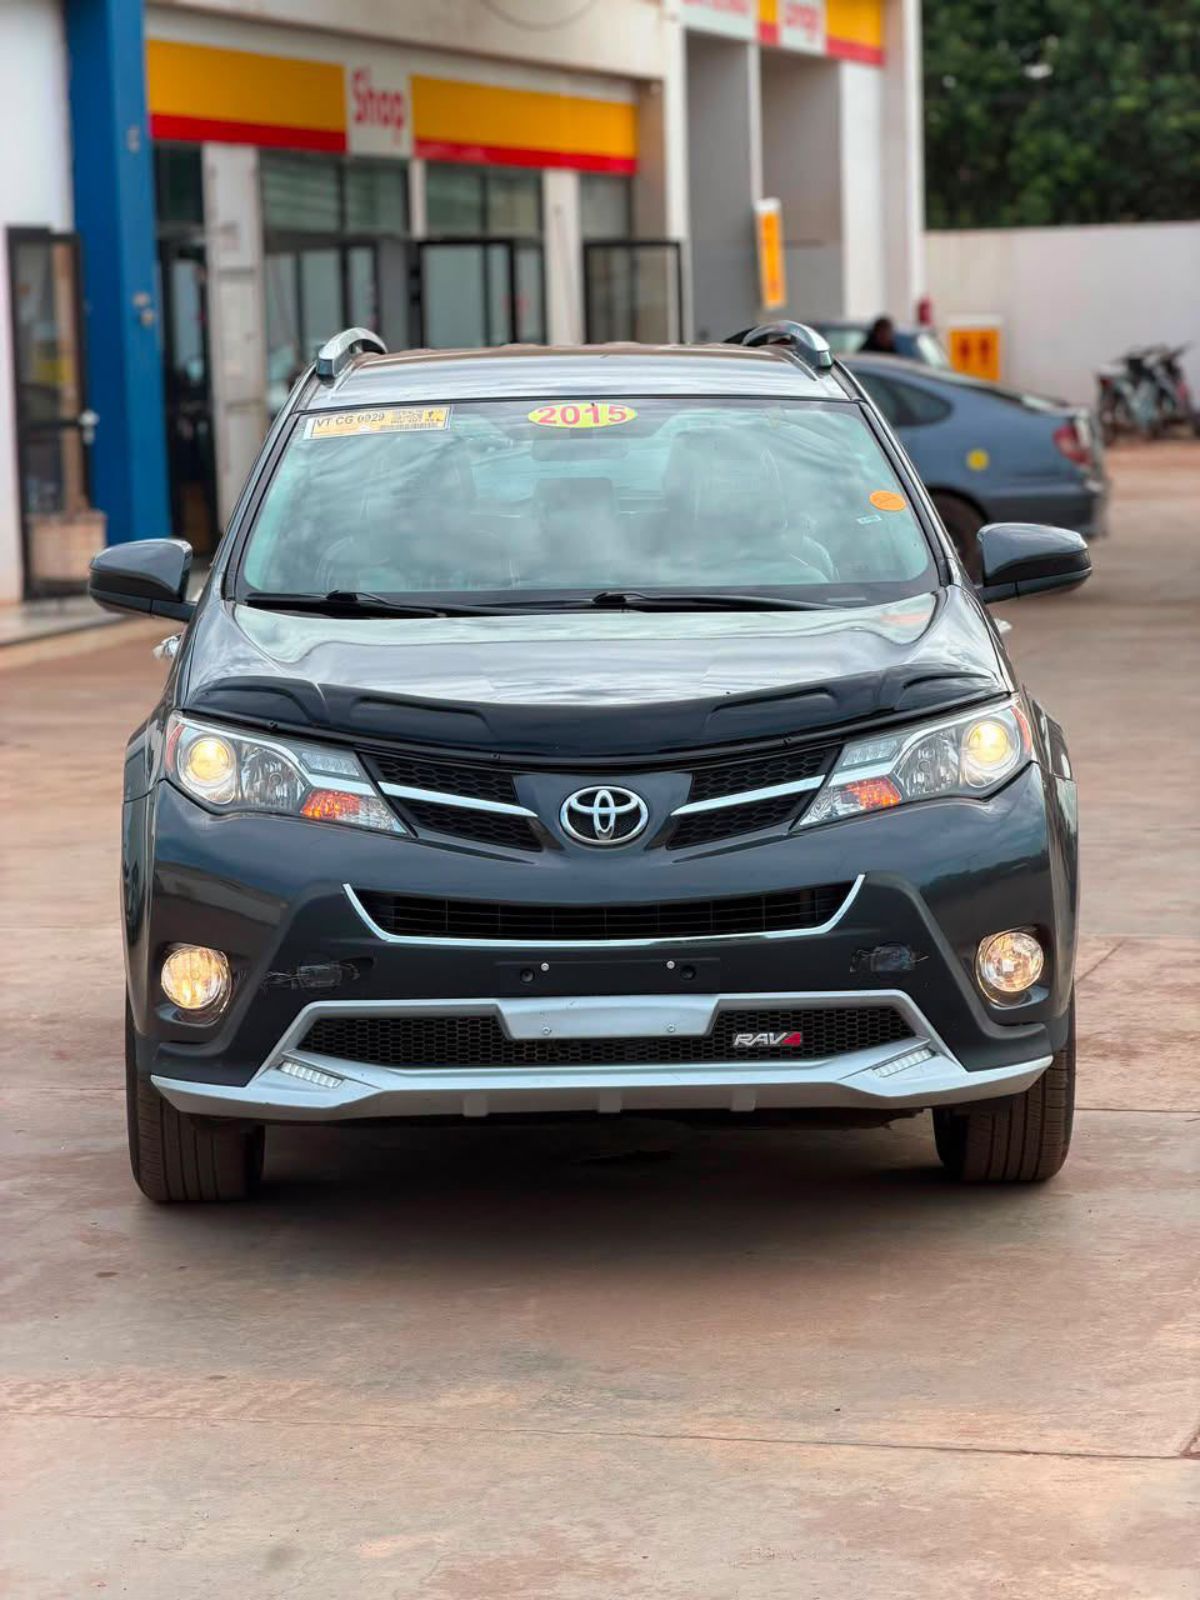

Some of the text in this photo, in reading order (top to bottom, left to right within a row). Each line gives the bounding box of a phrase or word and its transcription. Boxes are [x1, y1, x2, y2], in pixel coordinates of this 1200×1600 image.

[351, 67, 404, 144] Shop
[336, 415, 354, 425] CG
[537, 401, 628, 426] 2015
[733, 1031, 802, 1047] RAV4
